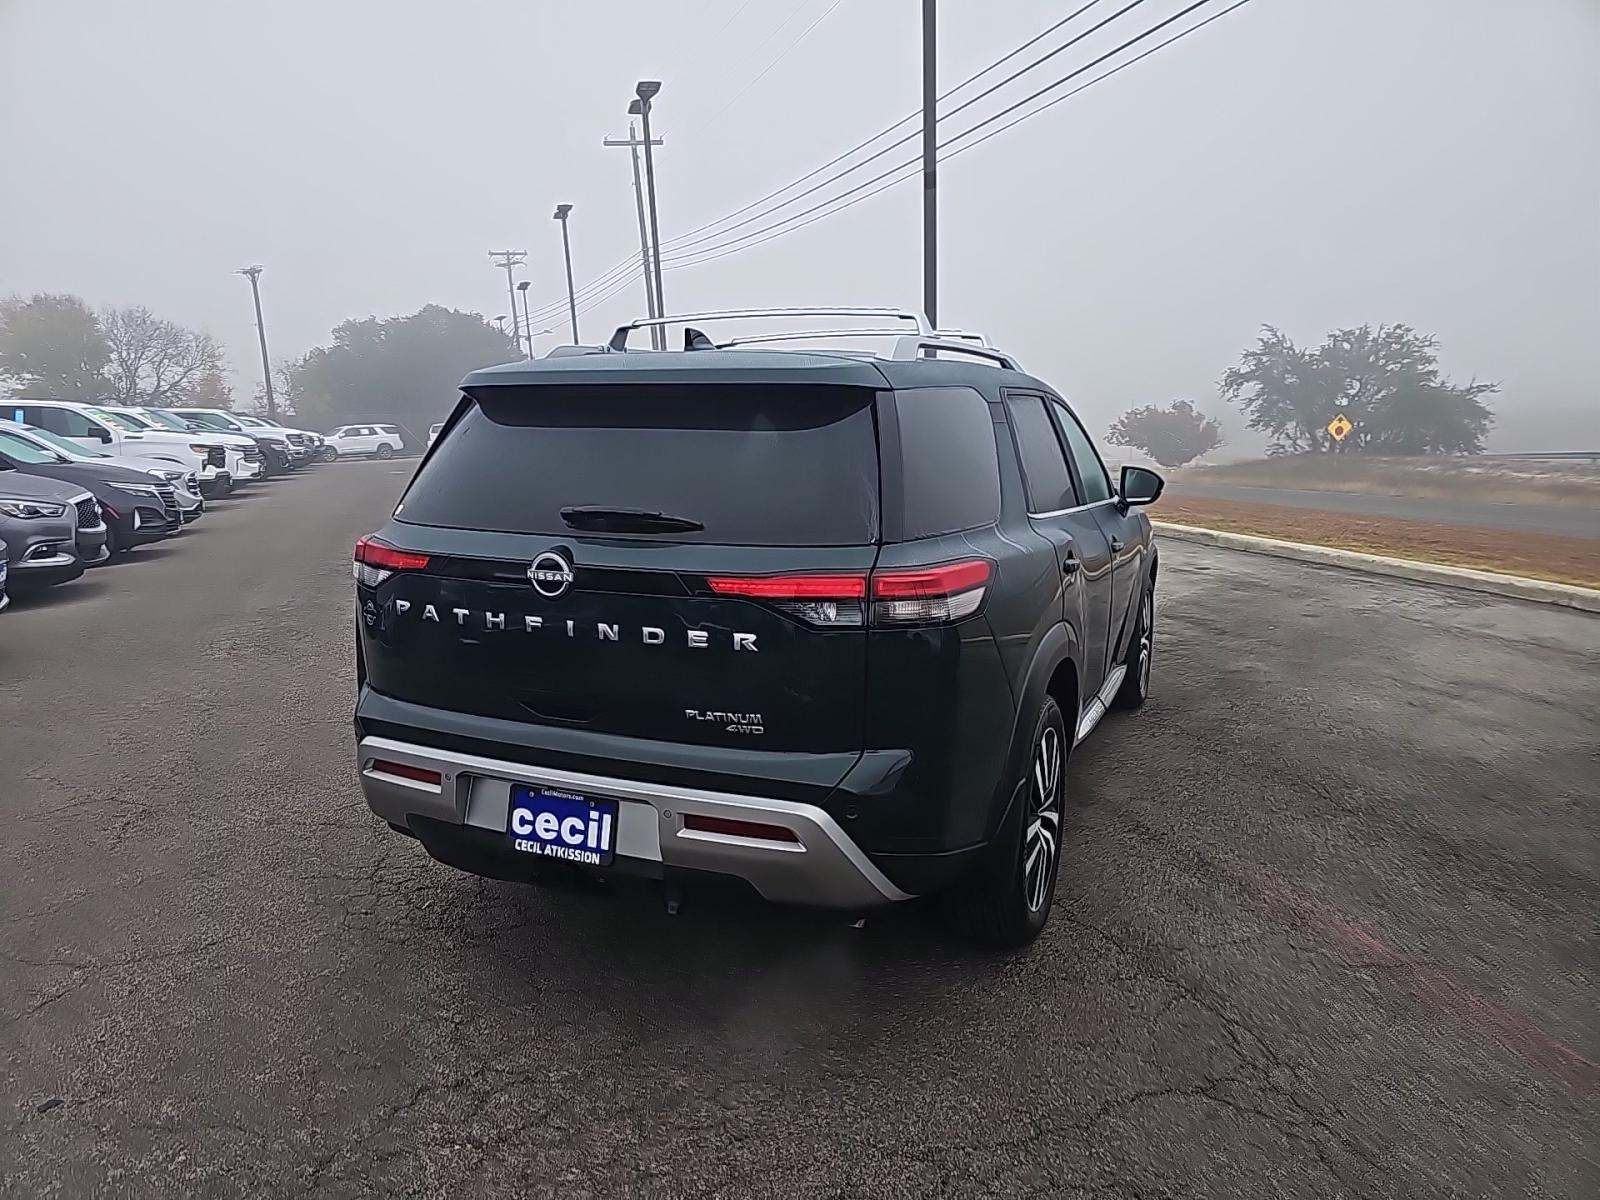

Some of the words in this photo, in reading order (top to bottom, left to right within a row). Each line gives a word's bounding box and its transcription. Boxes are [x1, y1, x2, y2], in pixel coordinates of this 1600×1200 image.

[527, 570, 574, 582] NISSAN
[396, 600, 759, 652] PATHFINDER
[685, 709, 763, 723] PLATINUM
[726, 724, 764, 734] 4WD
[511, 807, 612, 850] cecil
[514, 838, 542, 854] CECIL
[543, 844, 600, 865] ATKISSION
